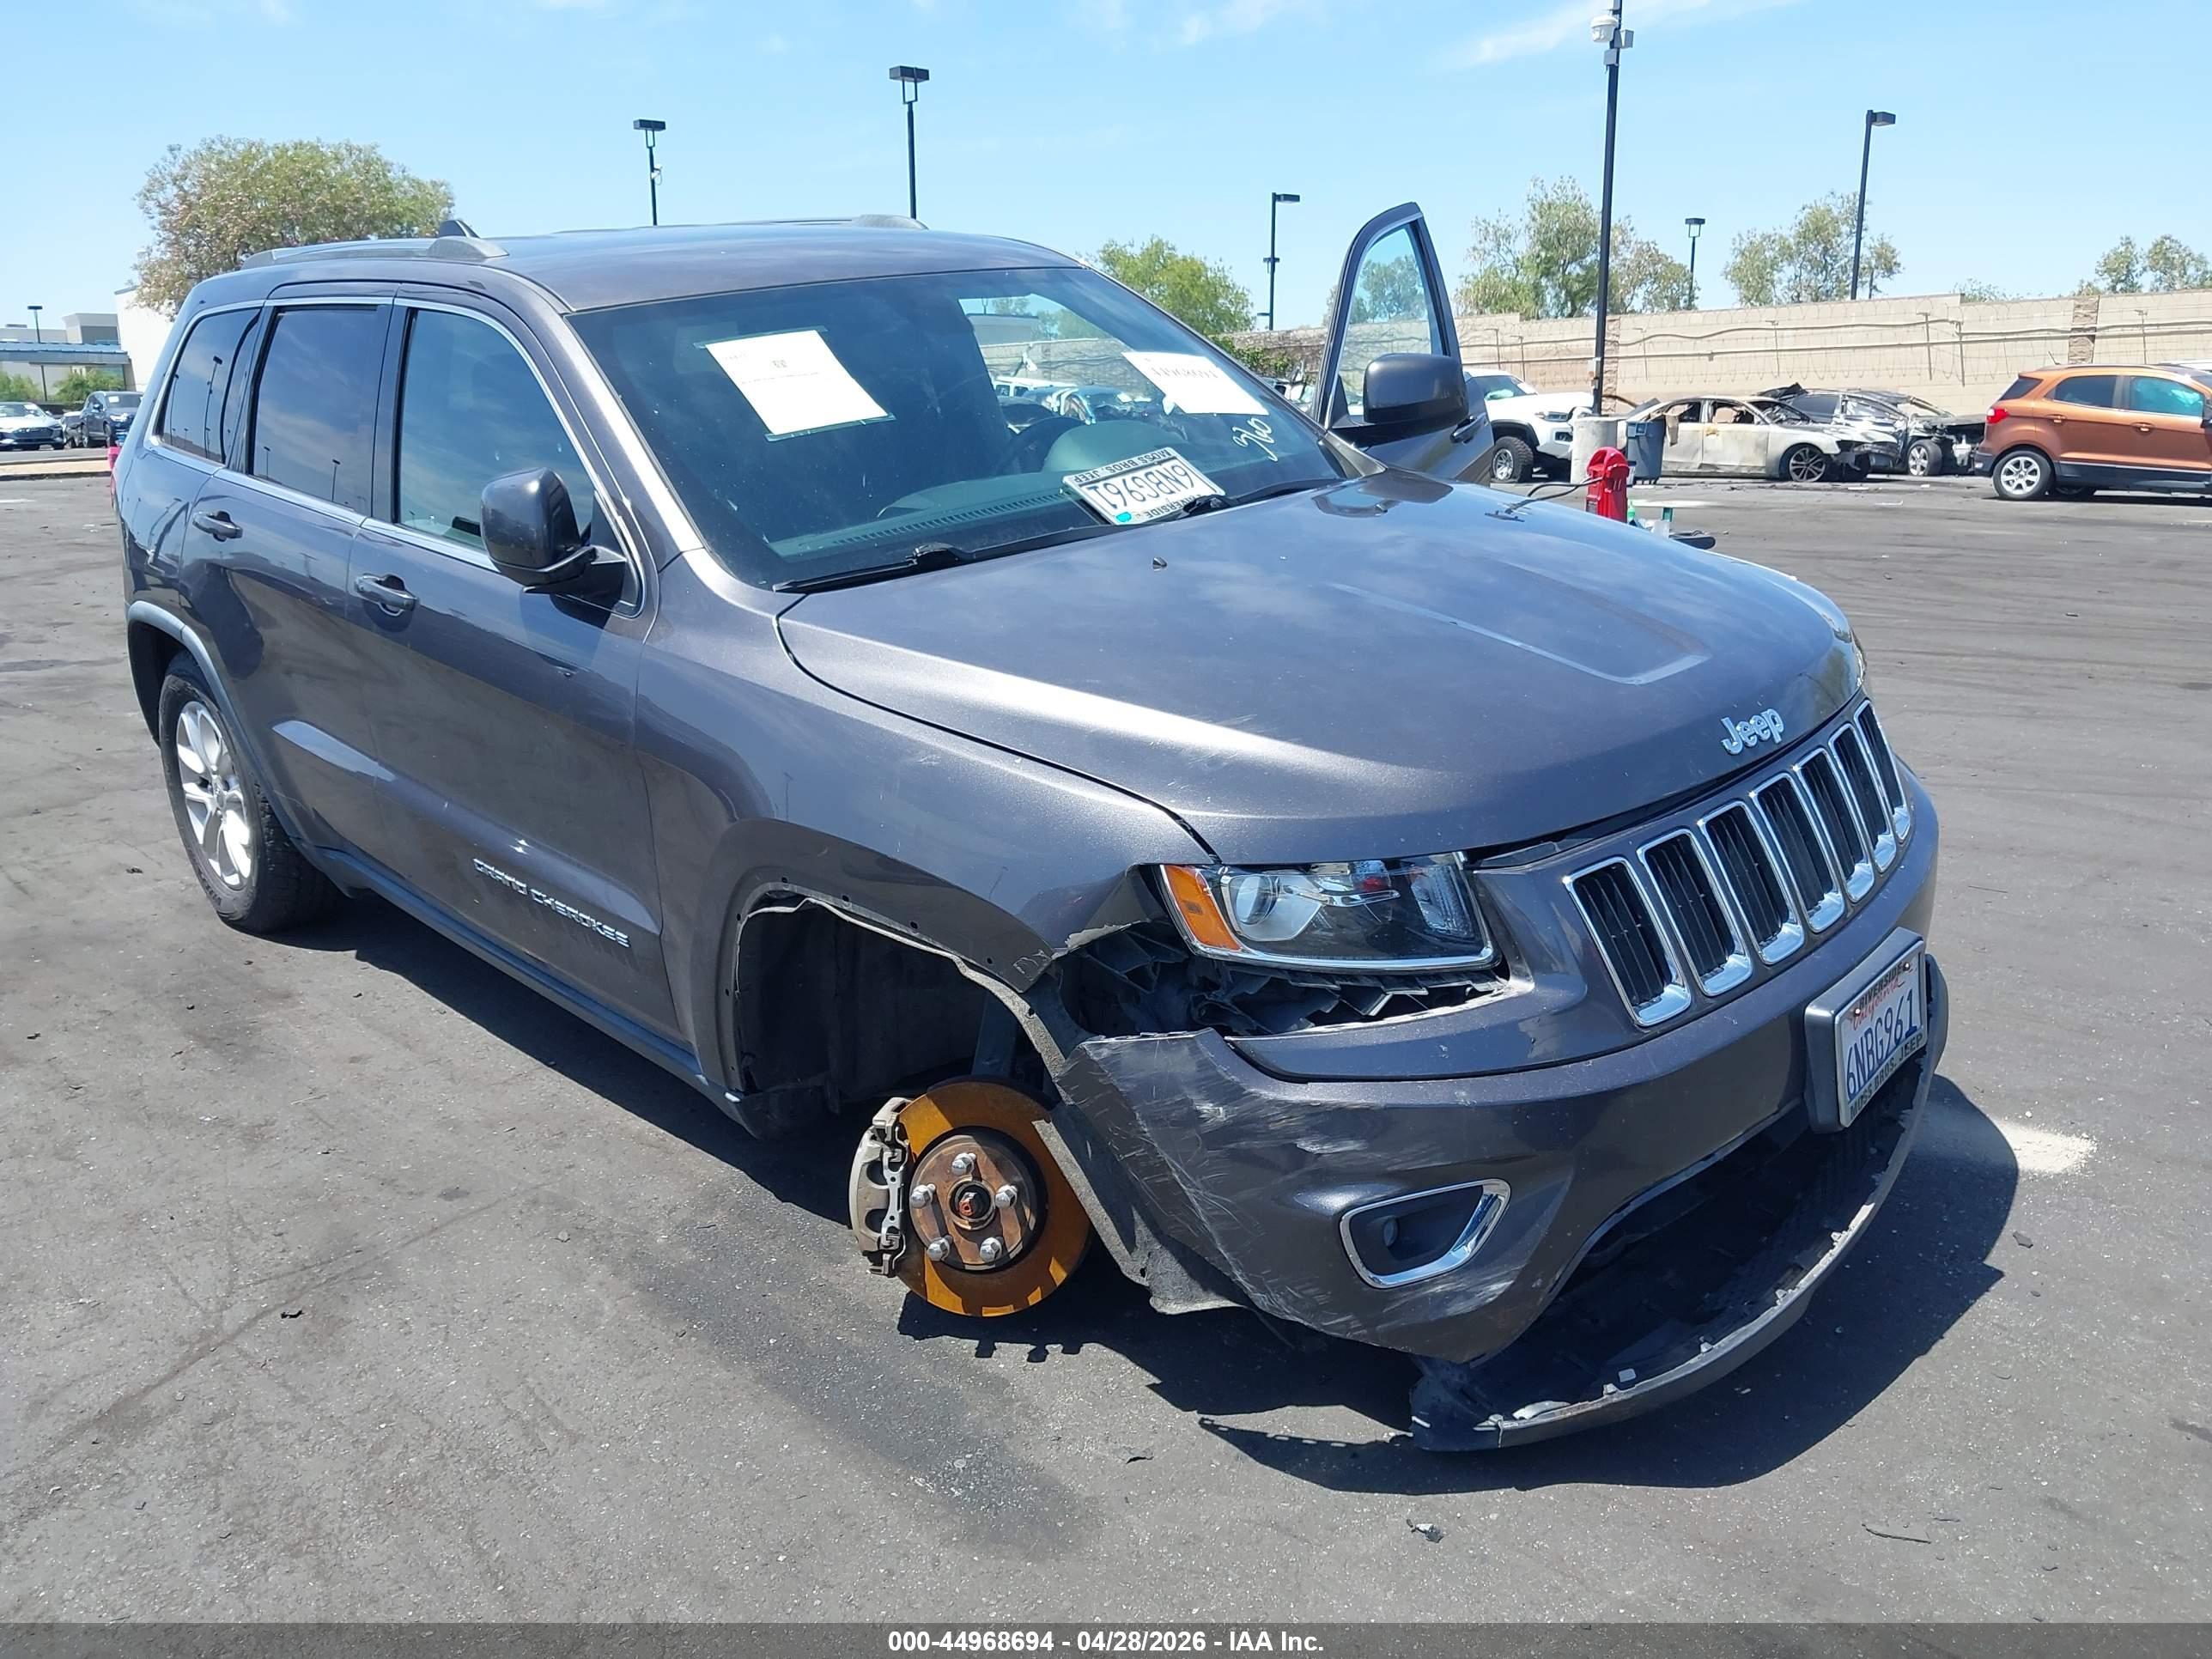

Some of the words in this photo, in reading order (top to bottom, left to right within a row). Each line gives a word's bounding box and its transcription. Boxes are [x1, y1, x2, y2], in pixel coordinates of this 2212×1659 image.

[1074, 470, 1100, 483] JEEP
[1102, 459, 1136, 474] BROS.
[1137, 449, 1171, 465] MOSS
[1088, 464, 1194, 509] 6NBG961
[1721, 708, 1784, 755] Jeep
[1859, 962, 1903, 1009] RIVERSIDE
[1847, 989, 1917, 1097] 6NBG961
[1850, 1085, 1872, 1121] MOSS
[1875, 1057, 1897, 1091] BROS.
[1899, 1033, 1923, 1062] JEEP
